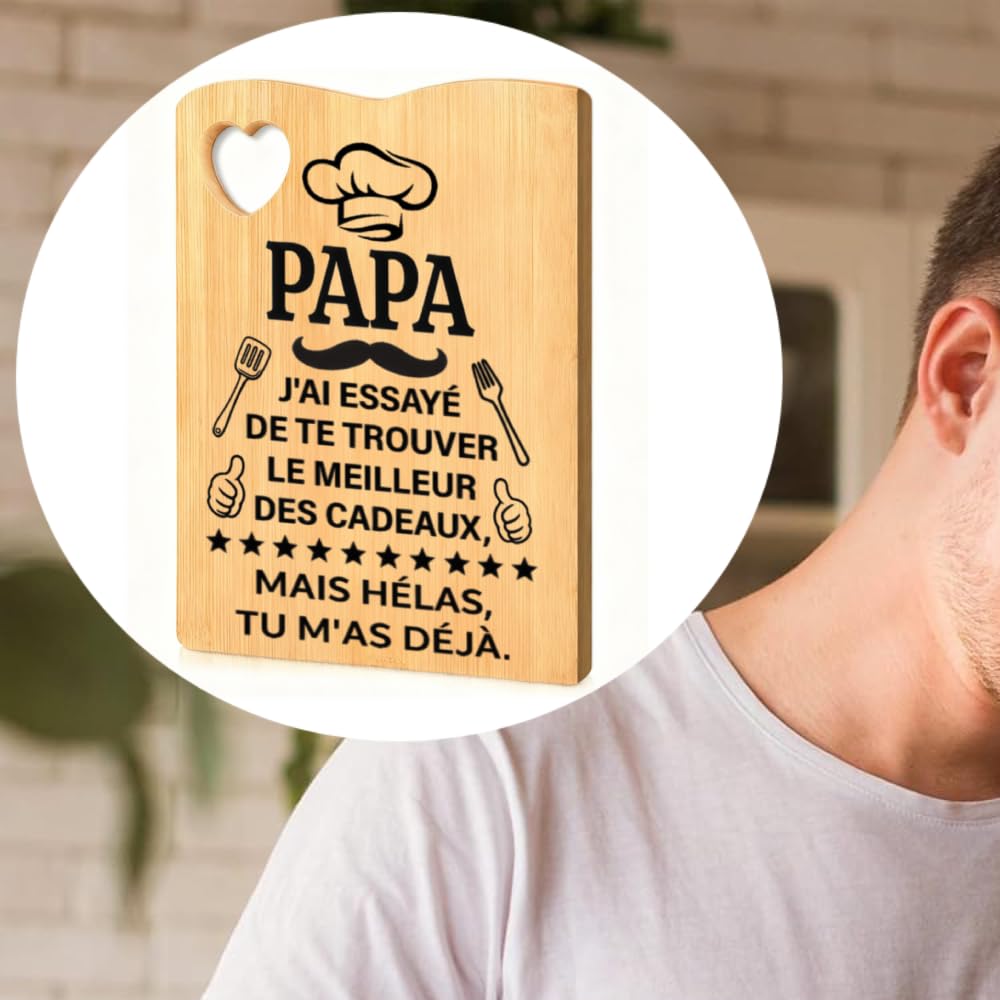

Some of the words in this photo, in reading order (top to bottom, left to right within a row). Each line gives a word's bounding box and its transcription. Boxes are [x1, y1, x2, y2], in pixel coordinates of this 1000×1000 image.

[266, 240, 475, 337] PAPA
[278, 377, 330, 406] J'AI
[340, 381, 461, 418] ESSAYÉ
[246, 413, 288, 443] DE
[294, 417, 335, 447] TE
[341, 421, 498, 462] TROUVER
[268, 456, 305, 485] LE
[314, 460, 476, 501] MEILLEUR
[254, 495, 318, 526] DES
[325, 502, 491, 548] CADEAUX,
[255, 569, 350, 603] MAIS
[362, 575, 492, 621] HÉLAS,
[235, 609, 286, 639] TU
[299, 615, 392, 649] M'AS
[404, 622, 511, 661] DÉJÀ.
